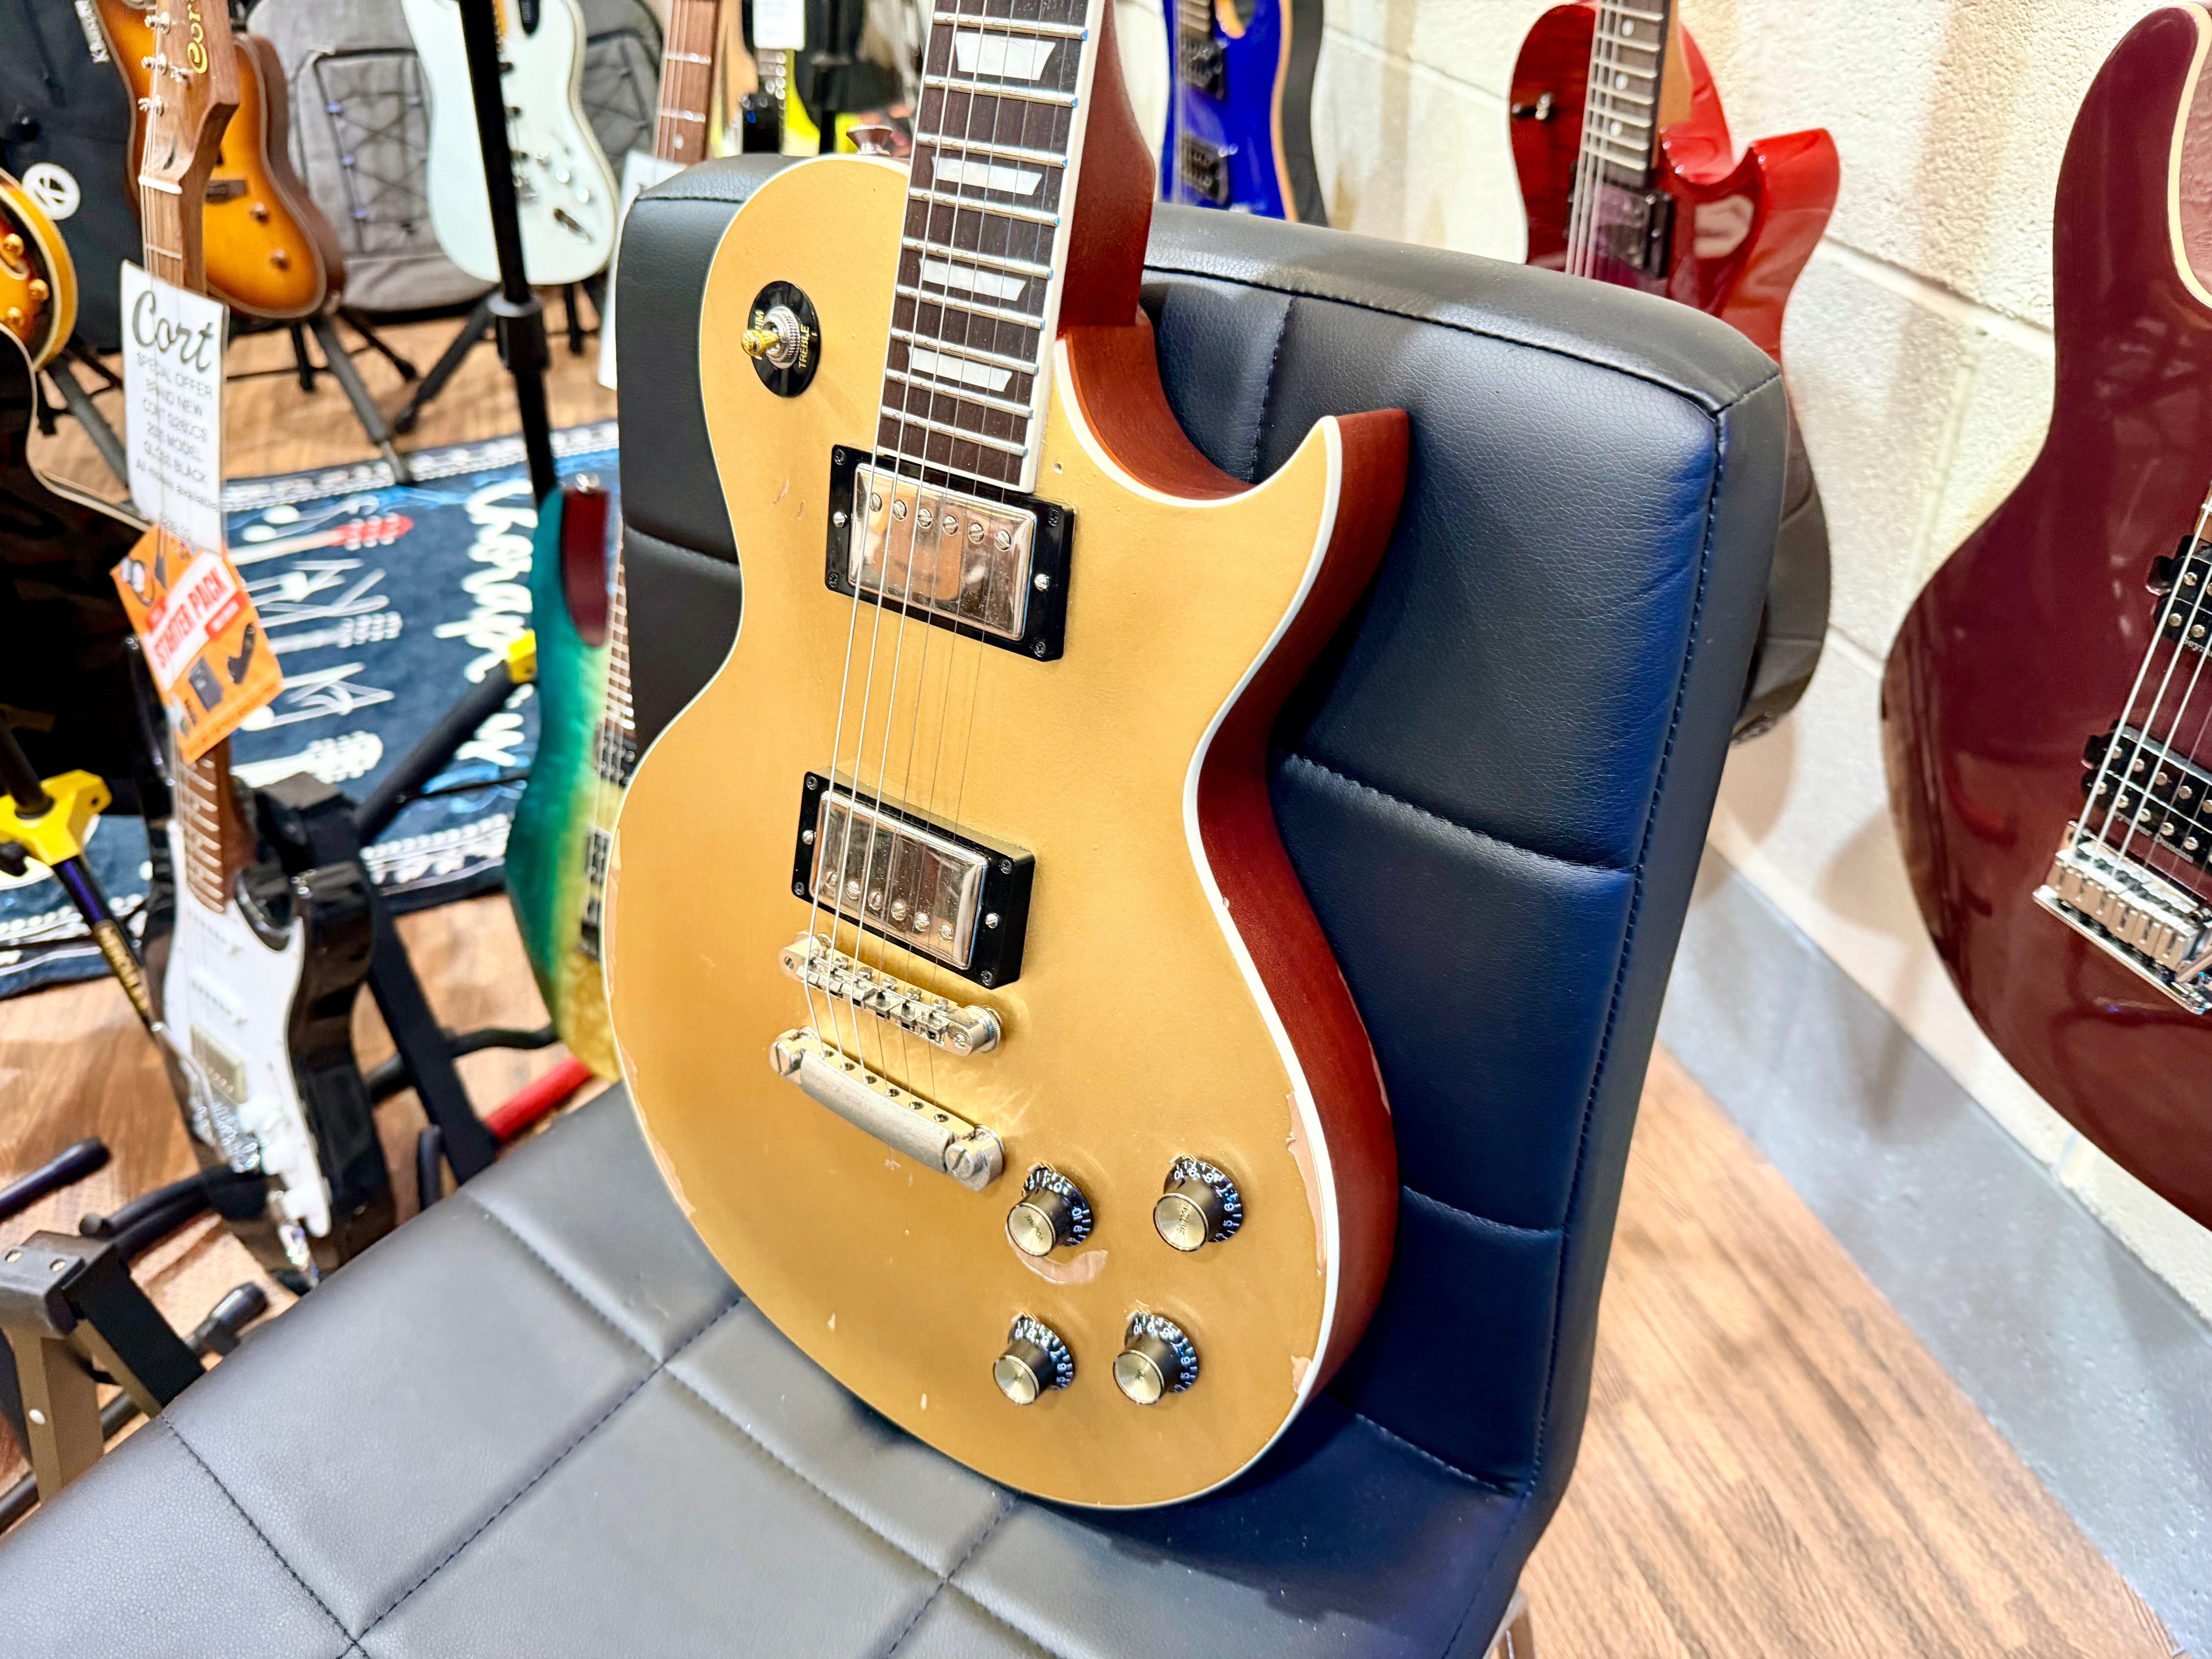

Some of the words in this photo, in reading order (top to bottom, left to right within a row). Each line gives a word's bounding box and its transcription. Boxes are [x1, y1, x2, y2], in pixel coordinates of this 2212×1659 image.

[187, 0, 208, 74] Cor
[132, 290, 215, 373] Cort
[799, 325, 810, 368] TREBLE
[188, 567, 228, 619] PACK
[1025, 1214, 1043, 1241] VOLUME
[1176, 1207, 1191, 1235] VOLUME
